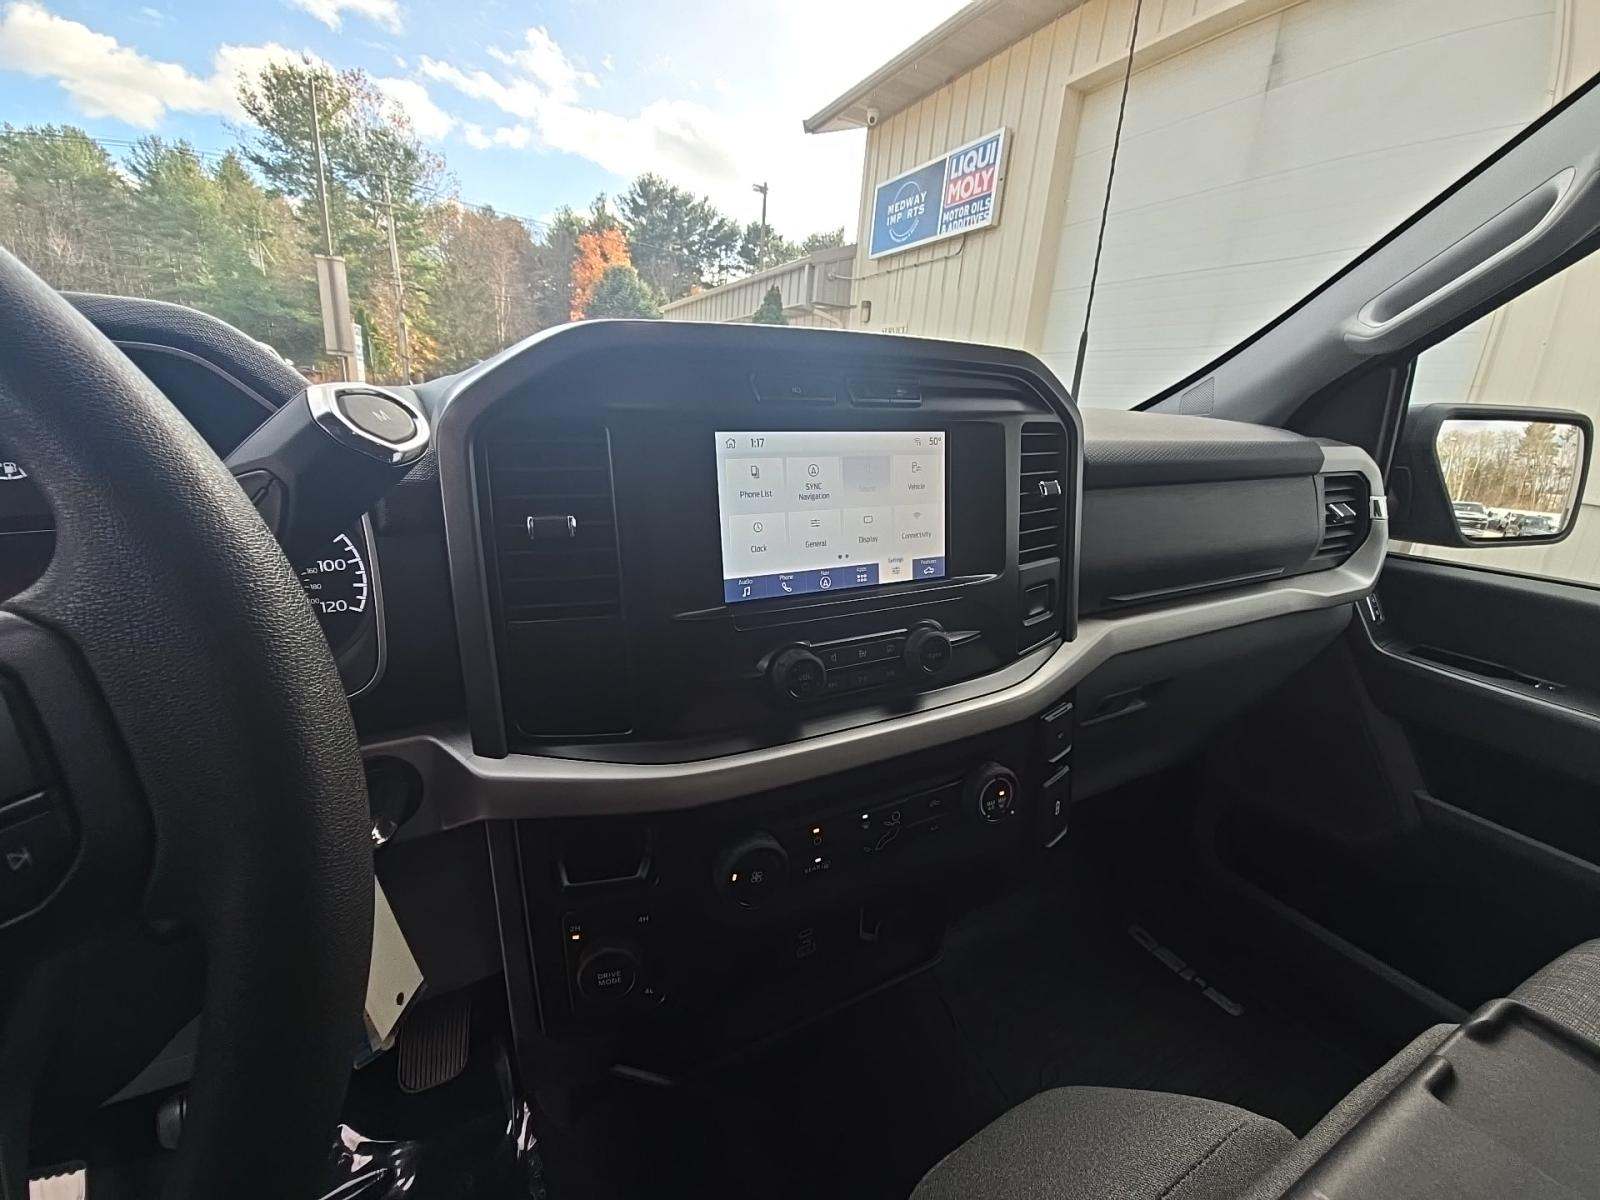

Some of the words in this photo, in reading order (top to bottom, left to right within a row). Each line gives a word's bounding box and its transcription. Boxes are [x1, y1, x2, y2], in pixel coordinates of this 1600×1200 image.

[951, 140, 998, 179] LIQUI
[947, 168, 994, 204] MOLY
[887, 191, 928, 215] MEDWAY
[943, 204, 970, 222] MOTOR
[971, 197, 991, 214] OILS
[750, 438, 765, 448] 1:17
[805, 482, 822, 491] SYNC
[907, 482, 926, 491] Vehicle
[739, 491, 760, 499] Phone
[761, 490, 772, 498] List
[798, 492, 830, 501] Navigation
[858, 535, 878, 544] Display
[901, 531, 932, 540] Connectivity
[805, 539, 827, 548] General
[750, 544, 767, 553] Clock
[317, 559, 346, 573] 100
[320, 600, 348, 613] 120
[597, 970, 622, 979] DRIVE
[598, 977, 622, 986] MODE
